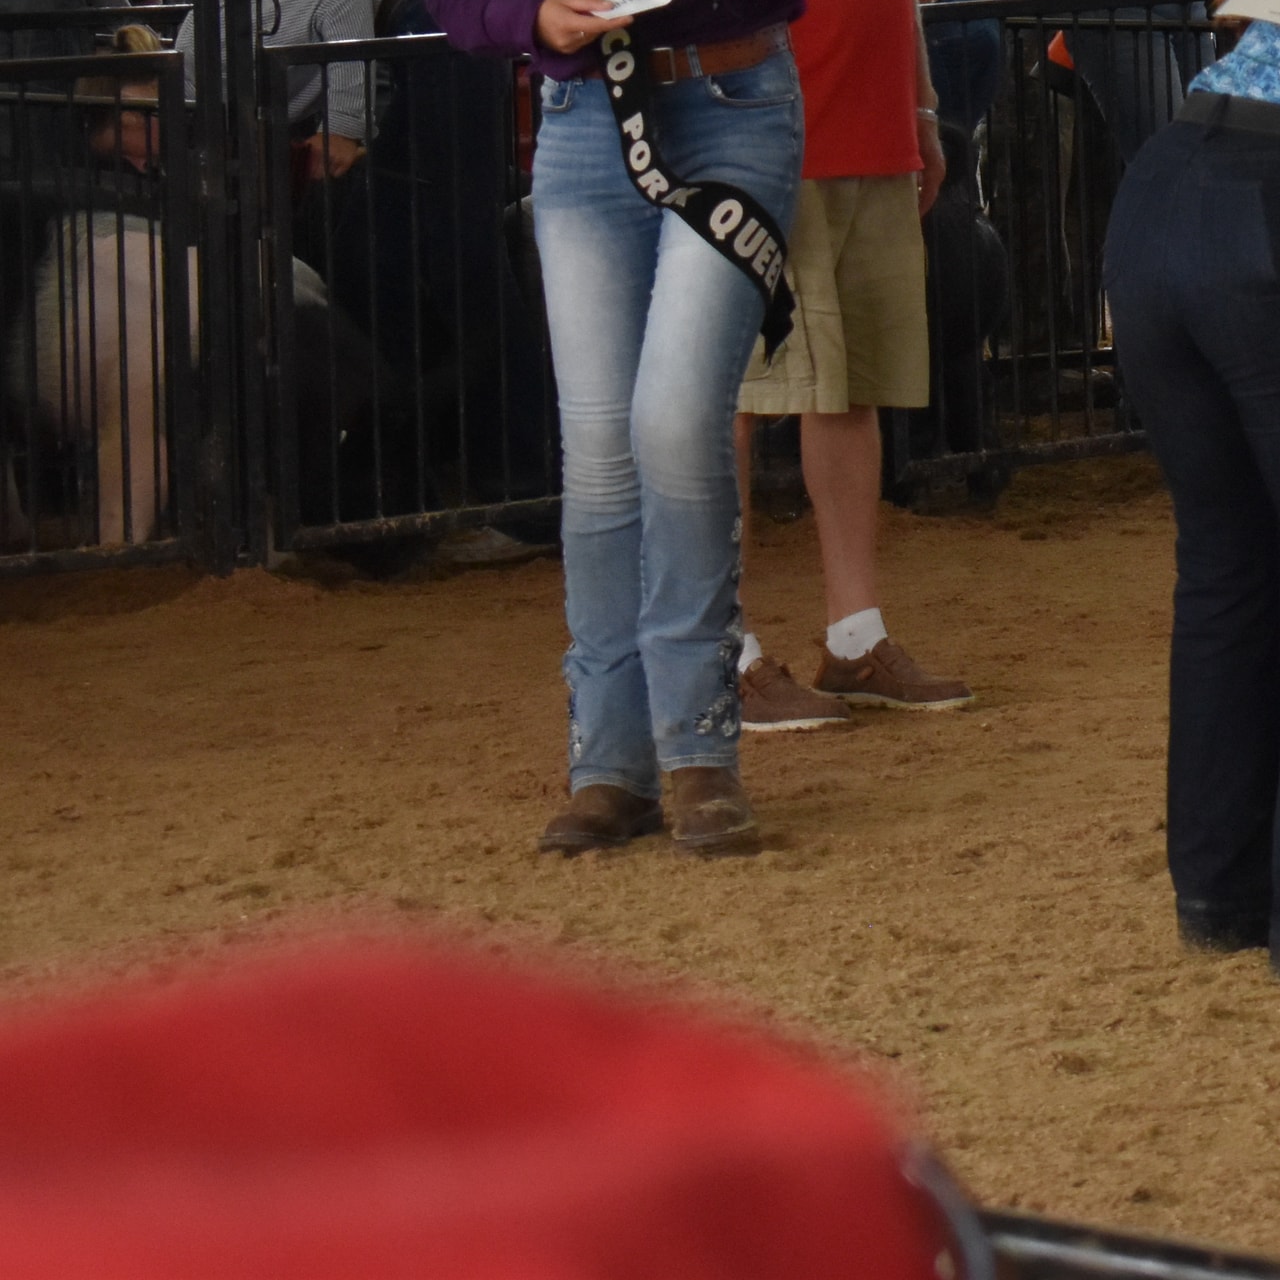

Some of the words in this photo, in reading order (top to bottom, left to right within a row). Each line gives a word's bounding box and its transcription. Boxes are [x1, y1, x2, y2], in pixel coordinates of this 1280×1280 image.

[602, 28, 635, 99] CO.
[622, 111, 702, 207] PORK
[709, 198, 784, 298] QUEE
